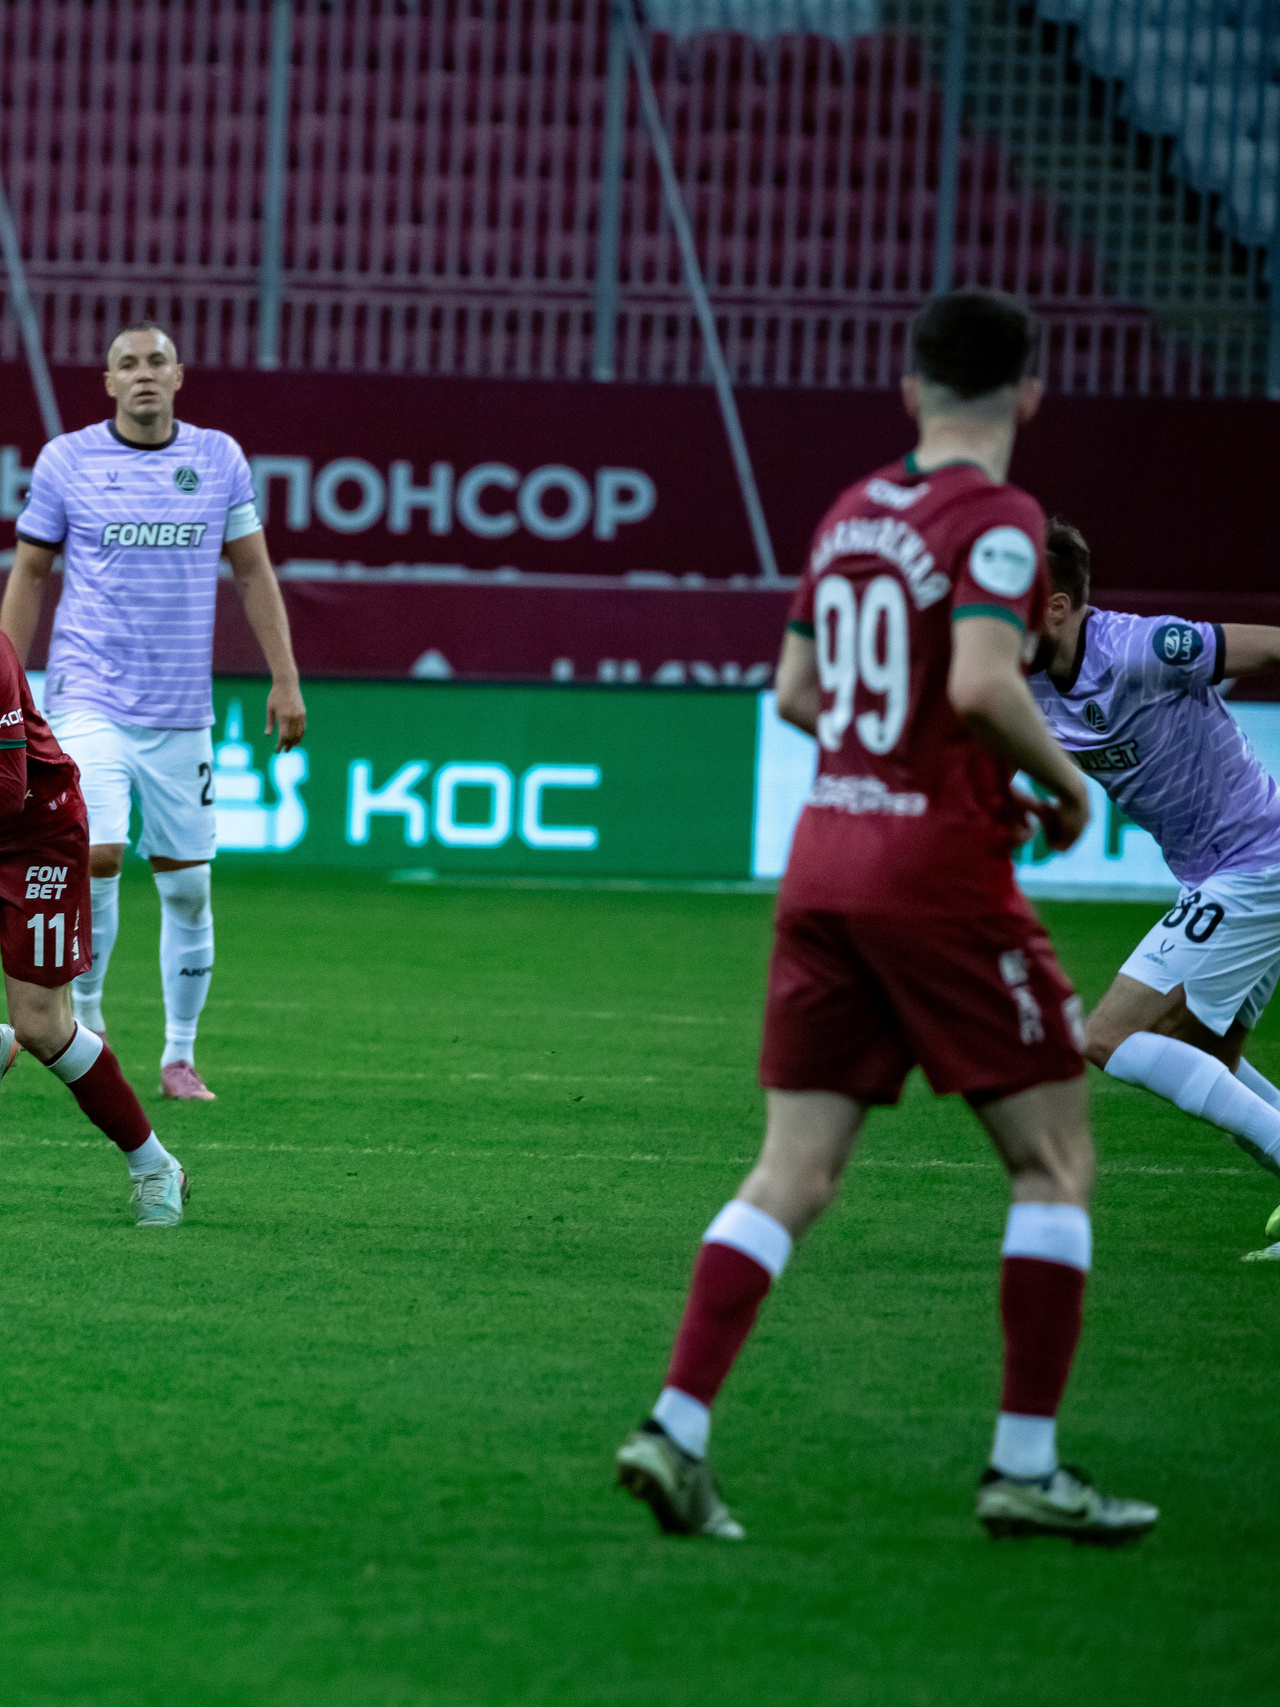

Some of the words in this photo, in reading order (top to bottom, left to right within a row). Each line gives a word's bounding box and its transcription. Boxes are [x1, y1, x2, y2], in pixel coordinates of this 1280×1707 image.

[249, 455, 657, 540] ПОНСОР
[102, 522, 208, 548] FONBET
[1180, 629, 1194, 661] LADA
[814, 574, 911, 756] 99
[25, 865, 69, 882] FON
[25, 883, 68, 900] BET
[27, 912, 66, 968] 11
